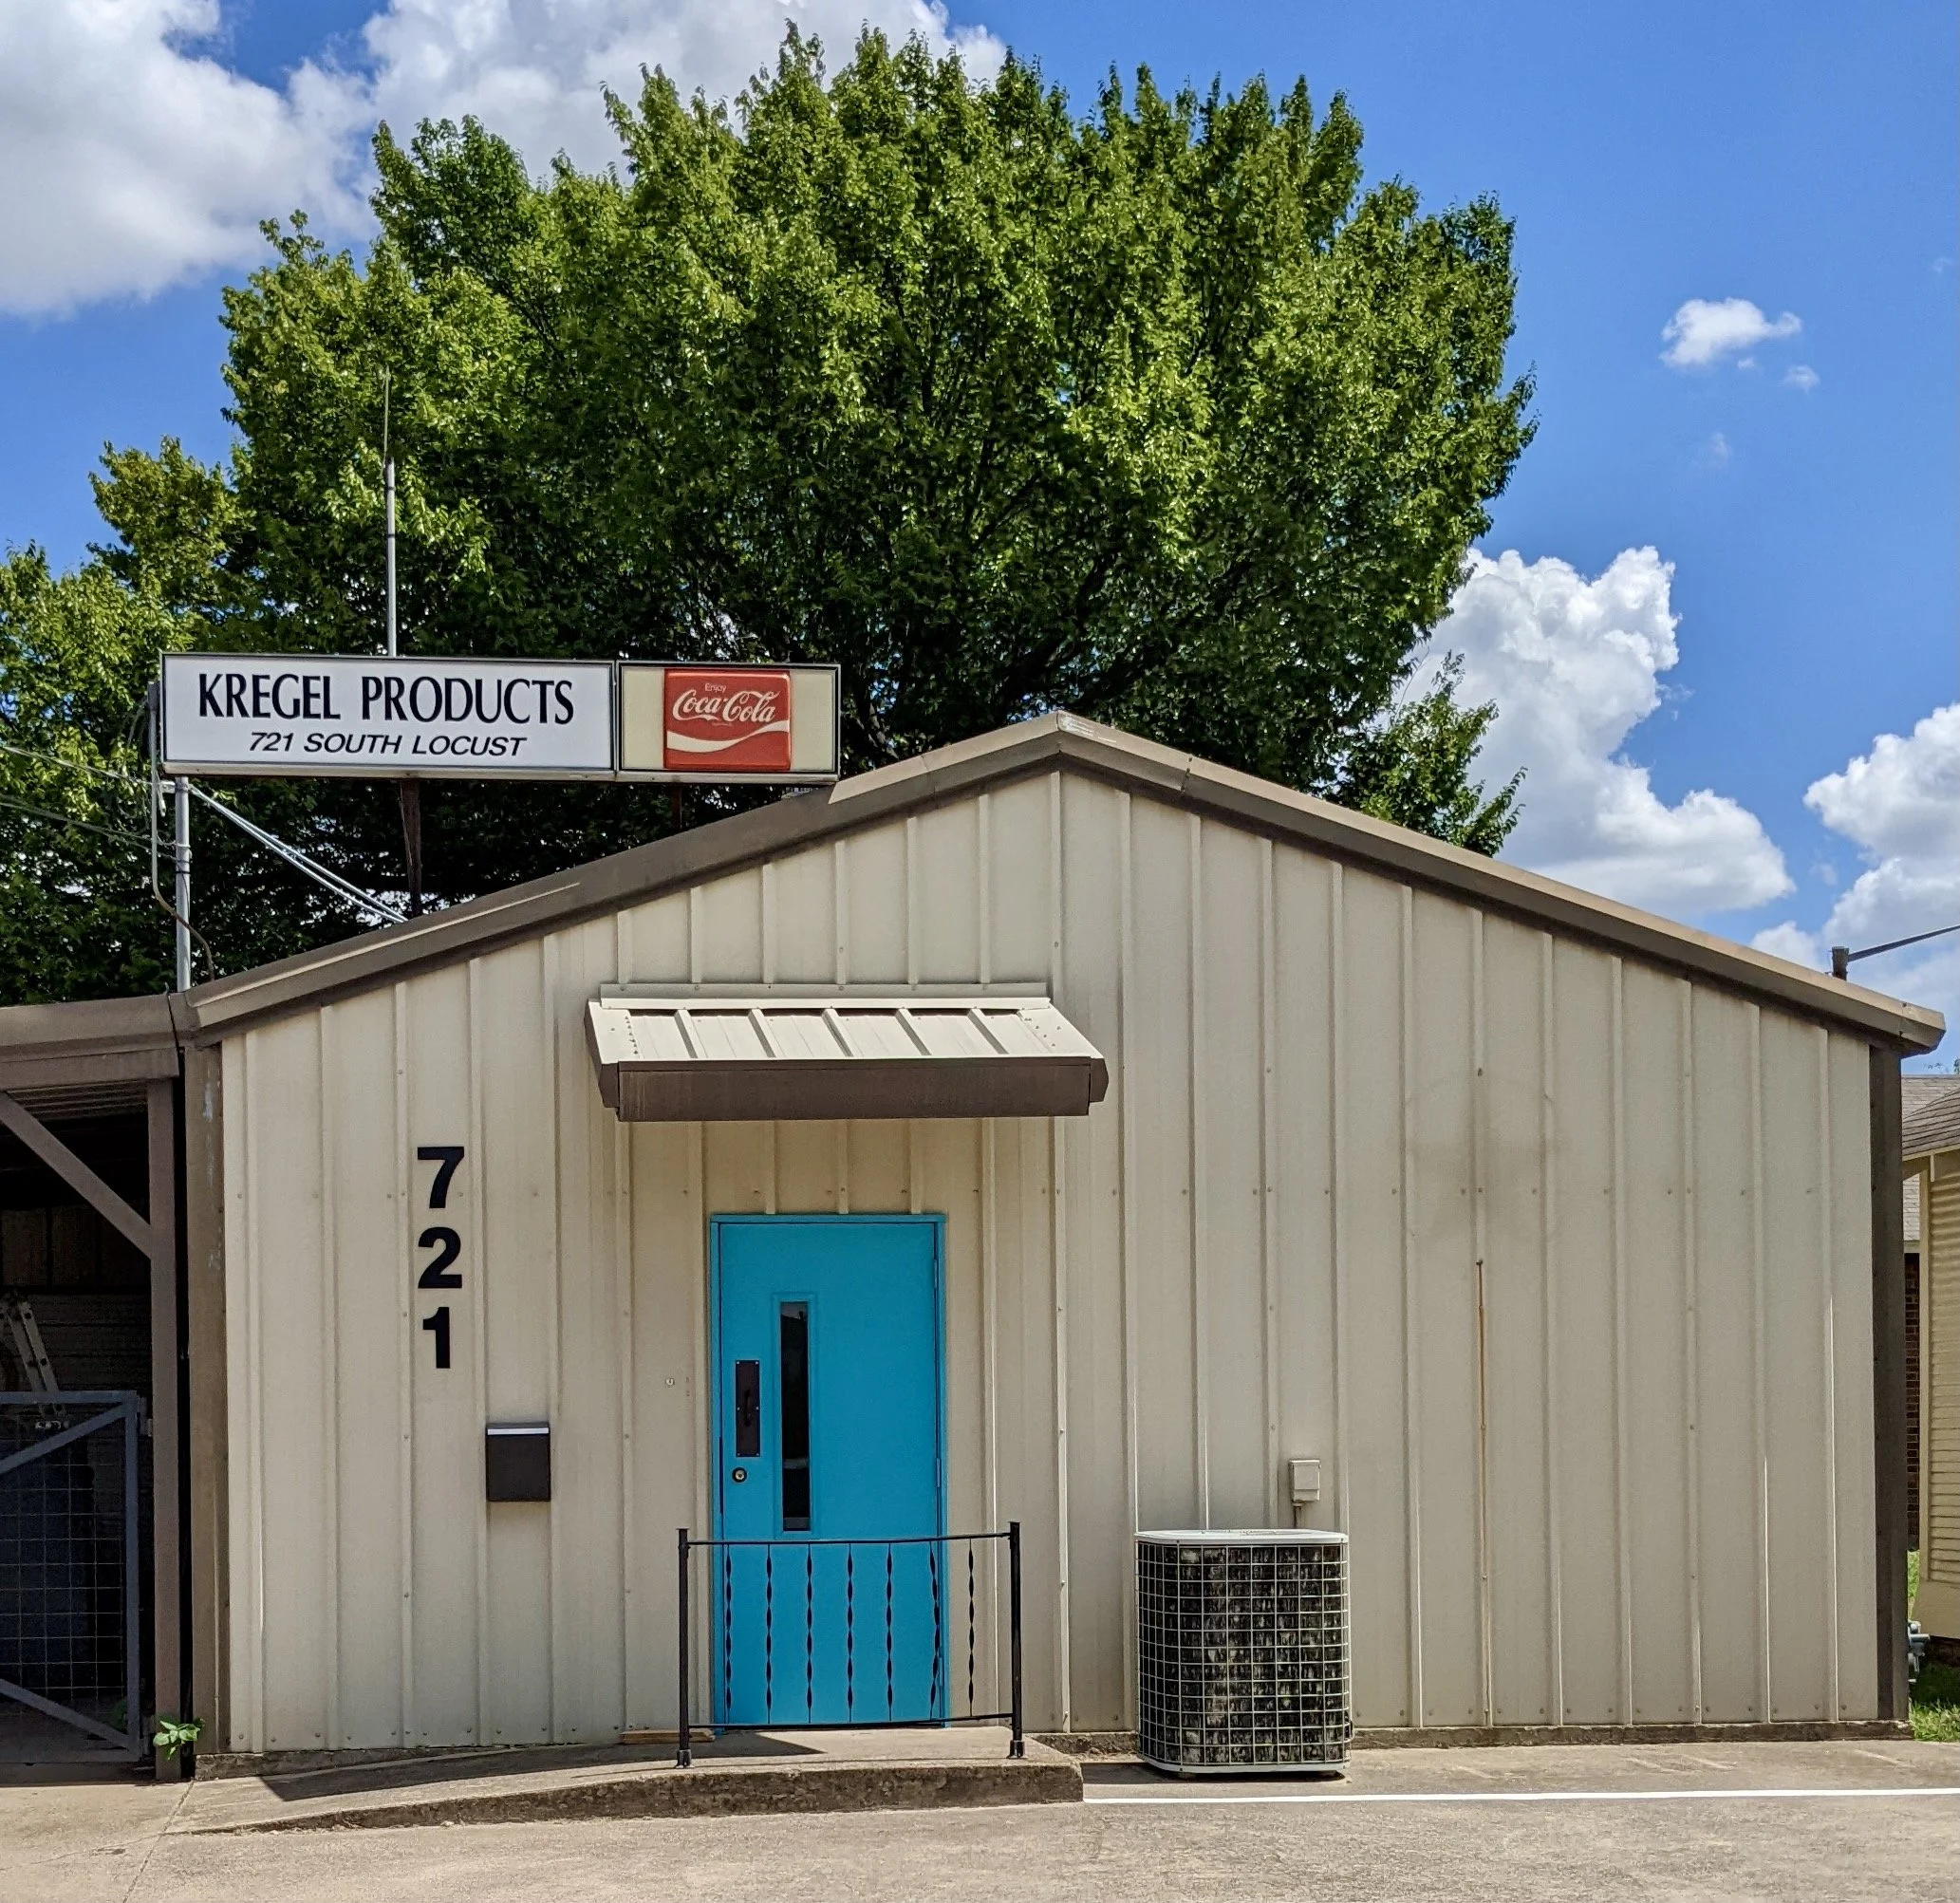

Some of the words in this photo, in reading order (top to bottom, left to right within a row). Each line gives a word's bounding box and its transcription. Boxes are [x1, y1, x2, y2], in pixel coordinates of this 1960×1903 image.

[198, 672, 342, 720] KREGEL
[361, 675, 574, 725] PRODUCTS
[704, 682, 727, 694] Enjoy
[672, 689, 780, 723] Coca-Cola
[249, 731, 294, 752] 721
[303, 732, 403, 755] SOUTH
[411, 735, 528, 756] LOCUST
